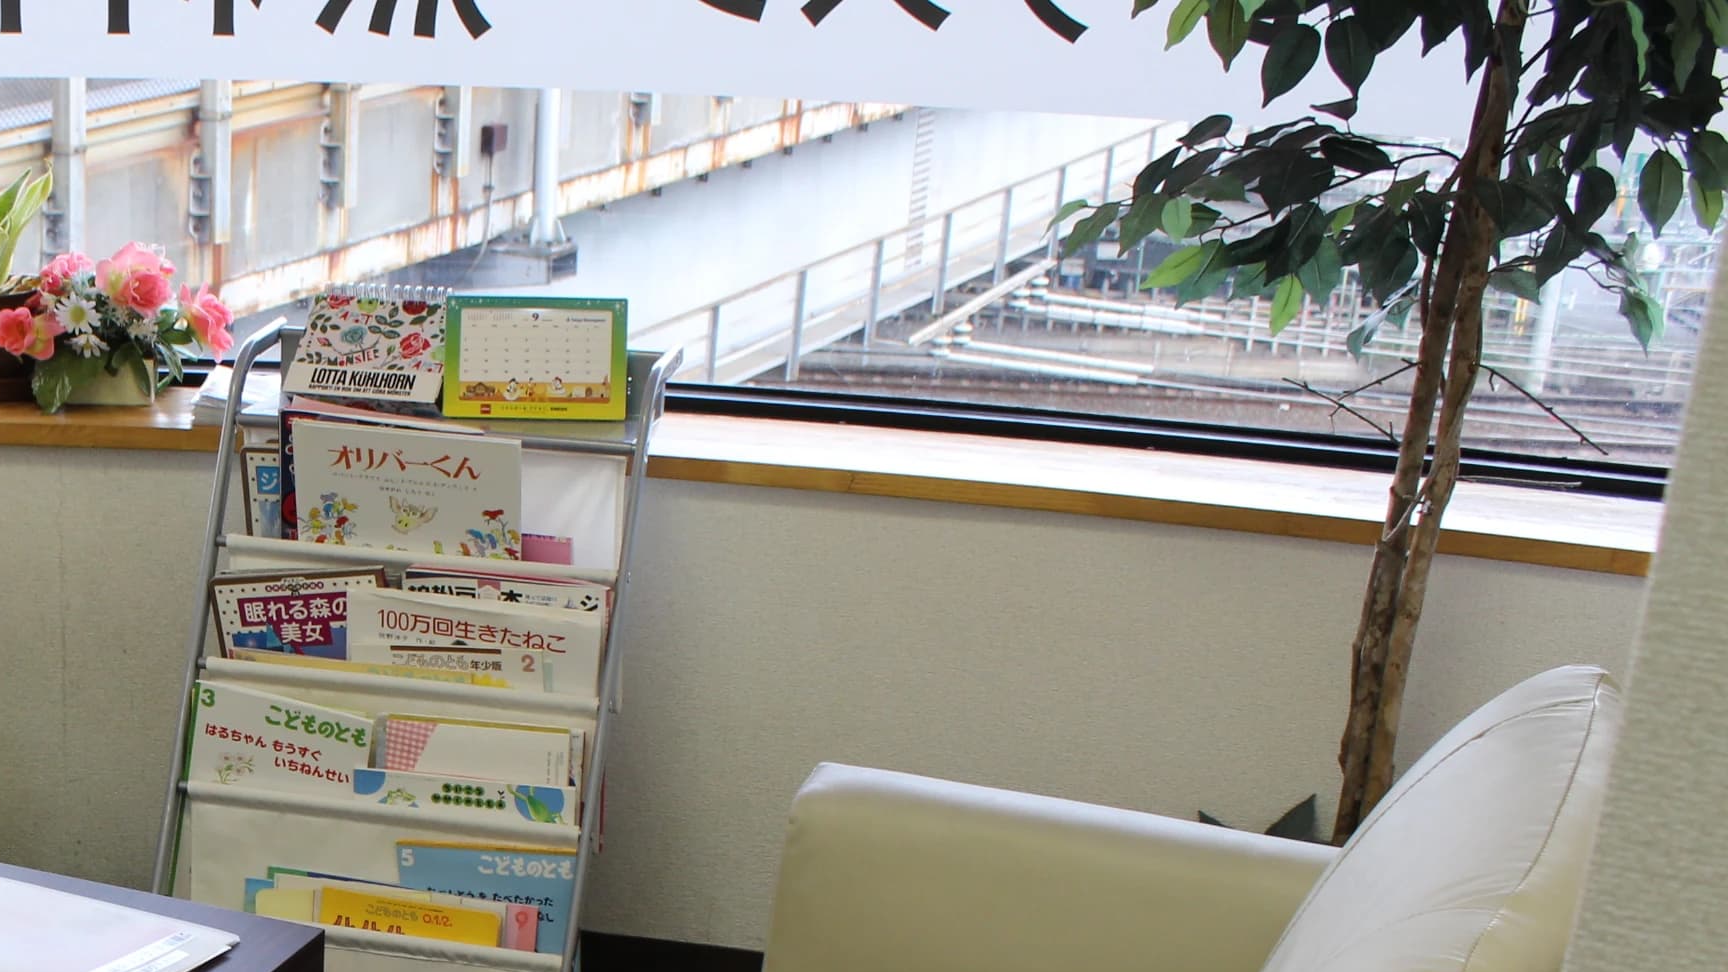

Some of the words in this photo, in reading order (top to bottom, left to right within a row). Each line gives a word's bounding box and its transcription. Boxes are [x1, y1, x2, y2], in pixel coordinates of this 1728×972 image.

[311, 368, 347, 386] LOTTA
[349, 370, 416, 391] KÜHLHORN
[328, 445, 480, 480] オリバーくん
[243, 596, 347, 623] 眠れる森の
[280, 621, 325, 644] 美女
[377, 609, 566, 653] 100万回生きたねこ
[521, 655, 535, 672] 2
[201, 689, 215, 707] 3
[265, 705, 367, 747] こどものとも
[205, 723, 267, 748] はるちゃん
[272, 740, 322, 761] もうすぐ
[274, 757, 350, 784] いちねんせい
[401, 849, 414, 866] 5
[477, 854, 574, 880] こどものとも
